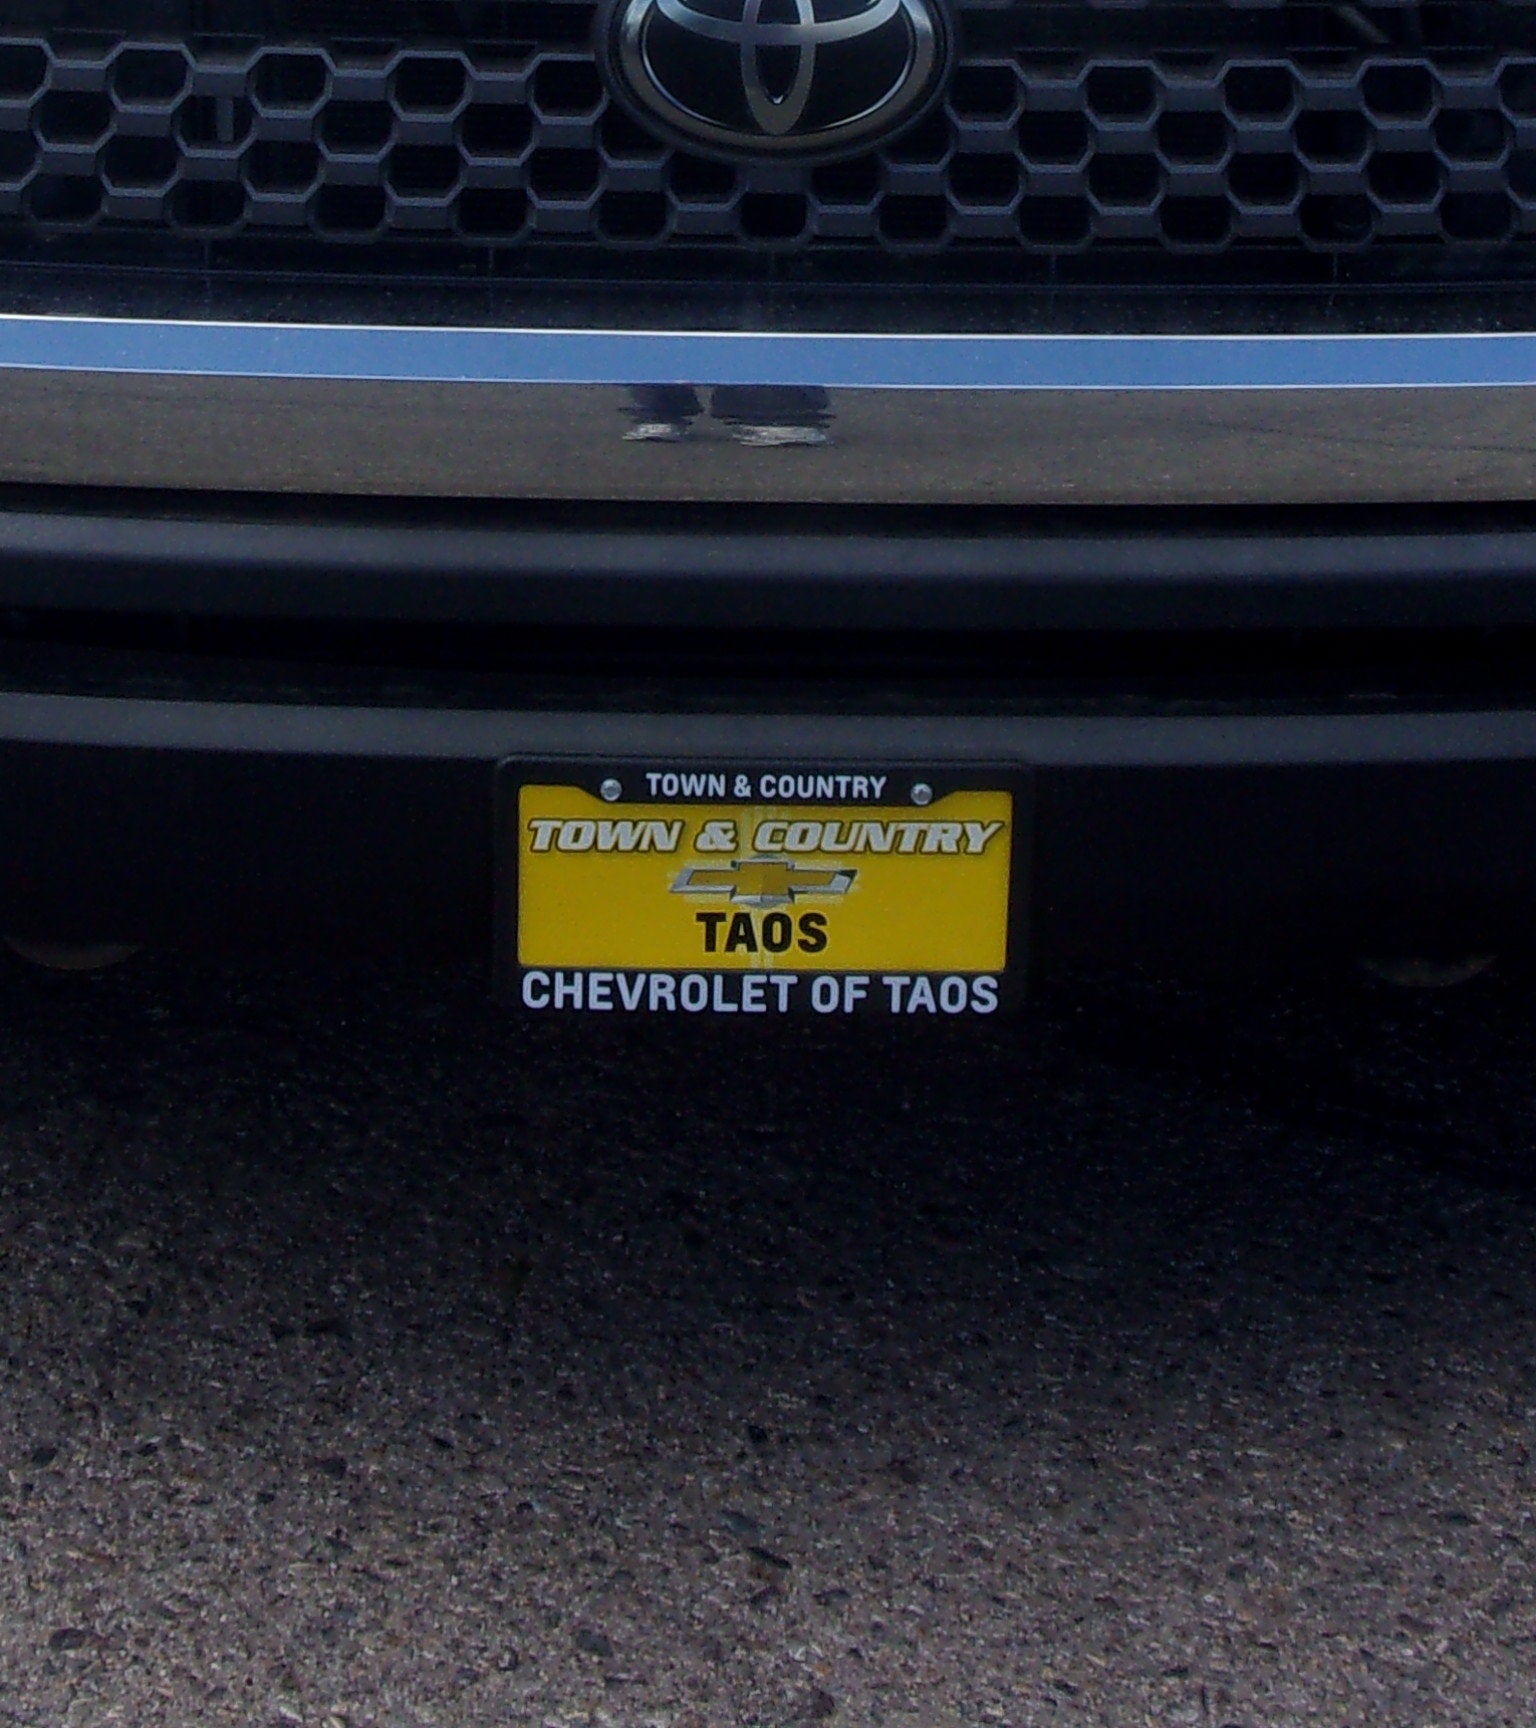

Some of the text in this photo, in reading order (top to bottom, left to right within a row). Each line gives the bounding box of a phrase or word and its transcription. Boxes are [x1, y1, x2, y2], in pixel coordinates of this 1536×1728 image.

[646, 773, 887, 800] TOWN & COUNTRY
[527, 818, 1004, 855] TOWN & COUNTRY
[696, 912, 828, 953] TAOS
[521, 970, 999, 1014] CHEVROLET OF TAOS
